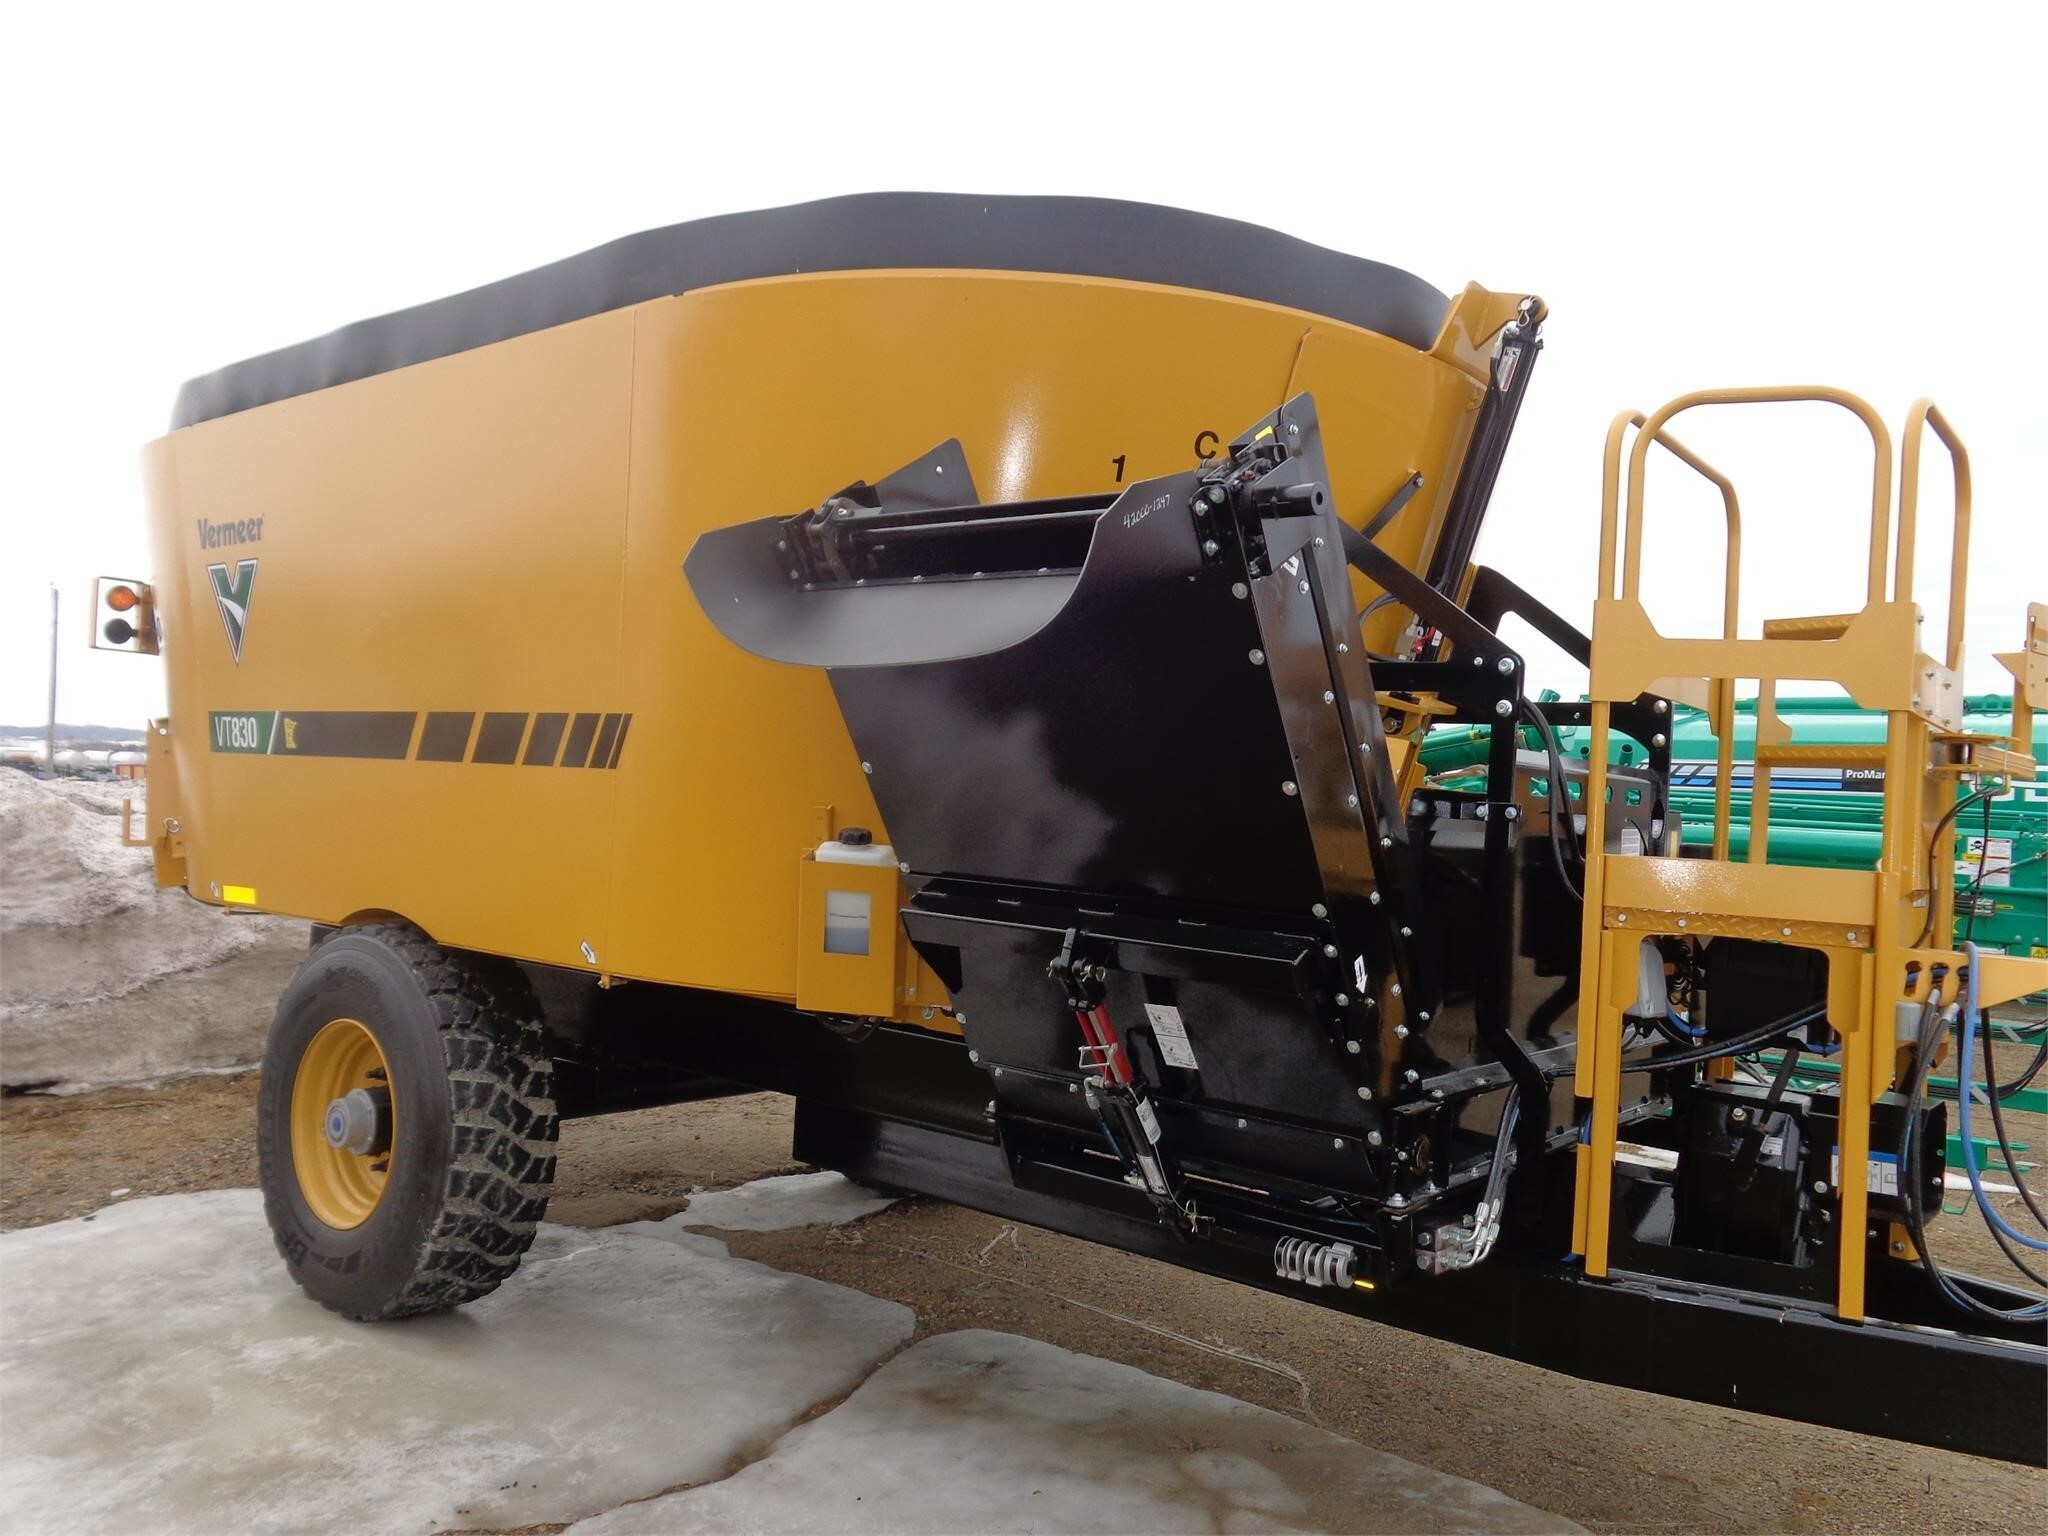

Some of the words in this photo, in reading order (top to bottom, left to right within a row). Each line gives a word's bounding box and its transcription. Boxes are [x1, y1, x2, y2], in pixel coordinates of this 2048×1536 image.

[1194, 430, 1219, 459] C
[1112, 454, 1125, 482] 1
[197, 517, 263, 549] Vermeer
[215, 716, 257, 748] VT830
